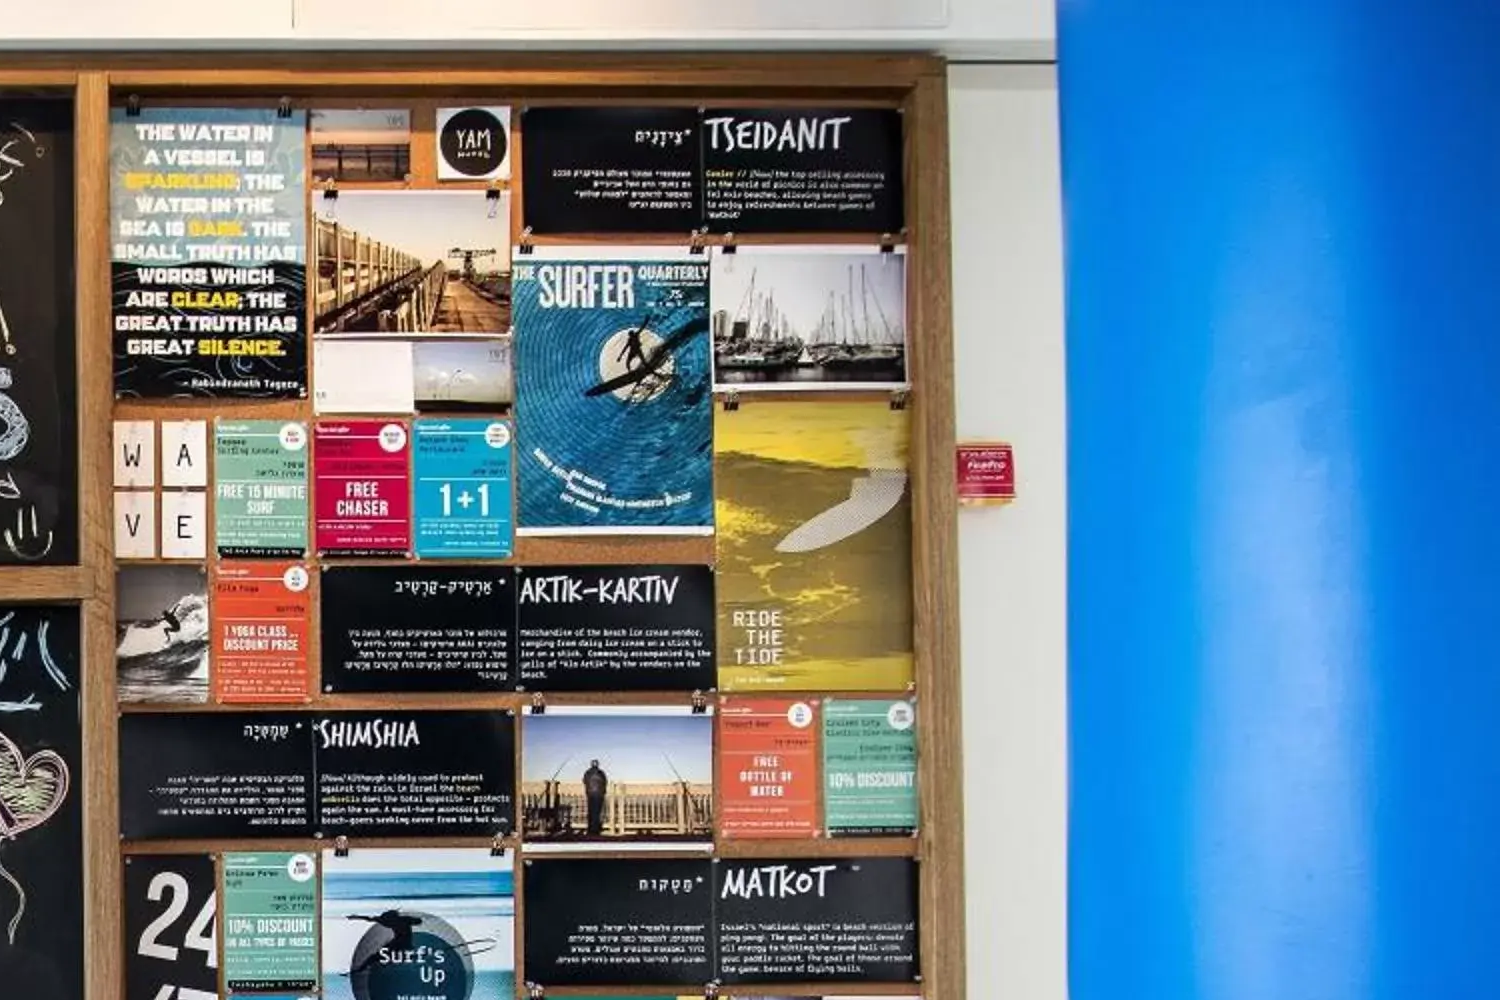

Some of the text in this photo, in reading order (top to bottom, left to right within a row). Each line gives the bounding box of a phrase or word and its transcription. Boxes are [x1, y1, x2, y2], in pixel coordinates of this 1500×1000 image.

[136, 124, 274, 143] THE WATER IN
[456, 128, 491, 151] YAM
[704, 116, 852, 153] TSEIDANIT
[144, 149, 265, 166] A VESSEL IS
[243, 173, 285, 191] THE
[136, 197, 275, 214] WATER IN THE
[119, 221, 162, 237] SEA
[165, 221, 185, 237] IS
[251, 221, 291, 237] THE
[114, 243, 297, 261] SMALL TRUTH HAS
[137, 267, 275, 285] WORDS WHICH
[512, 265, 709, 309] THE SURFER QUARTERLY
[126, 291, 169, 308] ARE
[245, 292, 287, 308] THE
[115, 315, 298, 332] GREAT TRUTH HAS
[126, 338, 287, 356] GREAT SILENCE.
[218, 484, 244, 499] FREE
[345, 481, 379, 497] FREE
[246, 500, 275, 514] SURF
[336, 500, 389, 516] CHASER
[439, 483, 489, 516] 1+1
[520, 575, 679, 604] ARTIK-KARTIV
[732, 611, 782, 627] RIDE
[746, 630, 782, 646] THE
[734, 649, 782, 665] TIDE
[320, 719, 420, 748] SHIMSHIA
[720, 865, 836, 899] MATKOT
[138, 871, 217, 969] 24
[257, 919, 313, 933] DISCOUNT
[379, 945, 445, 964] Surf's
[421, 966, 445, 987] Up
